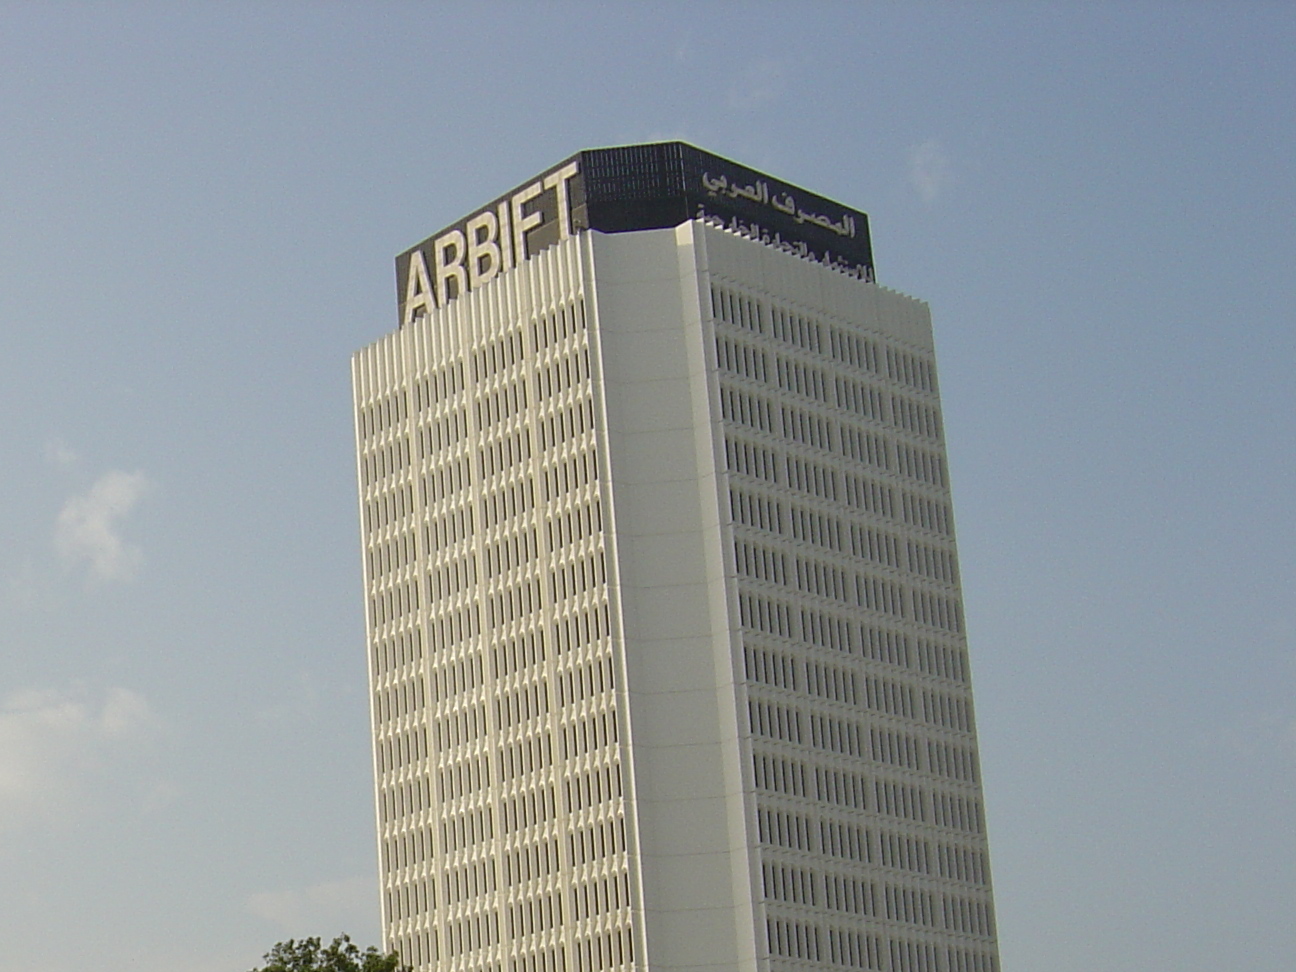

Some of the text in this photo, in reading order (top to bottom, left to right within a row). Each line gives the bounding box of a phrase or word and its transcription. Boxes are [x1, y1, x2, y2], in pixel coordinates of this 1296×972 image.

[404, 161, 581, 327] ARBIFT
[702, 171, 855, 239] المصرف العربي
